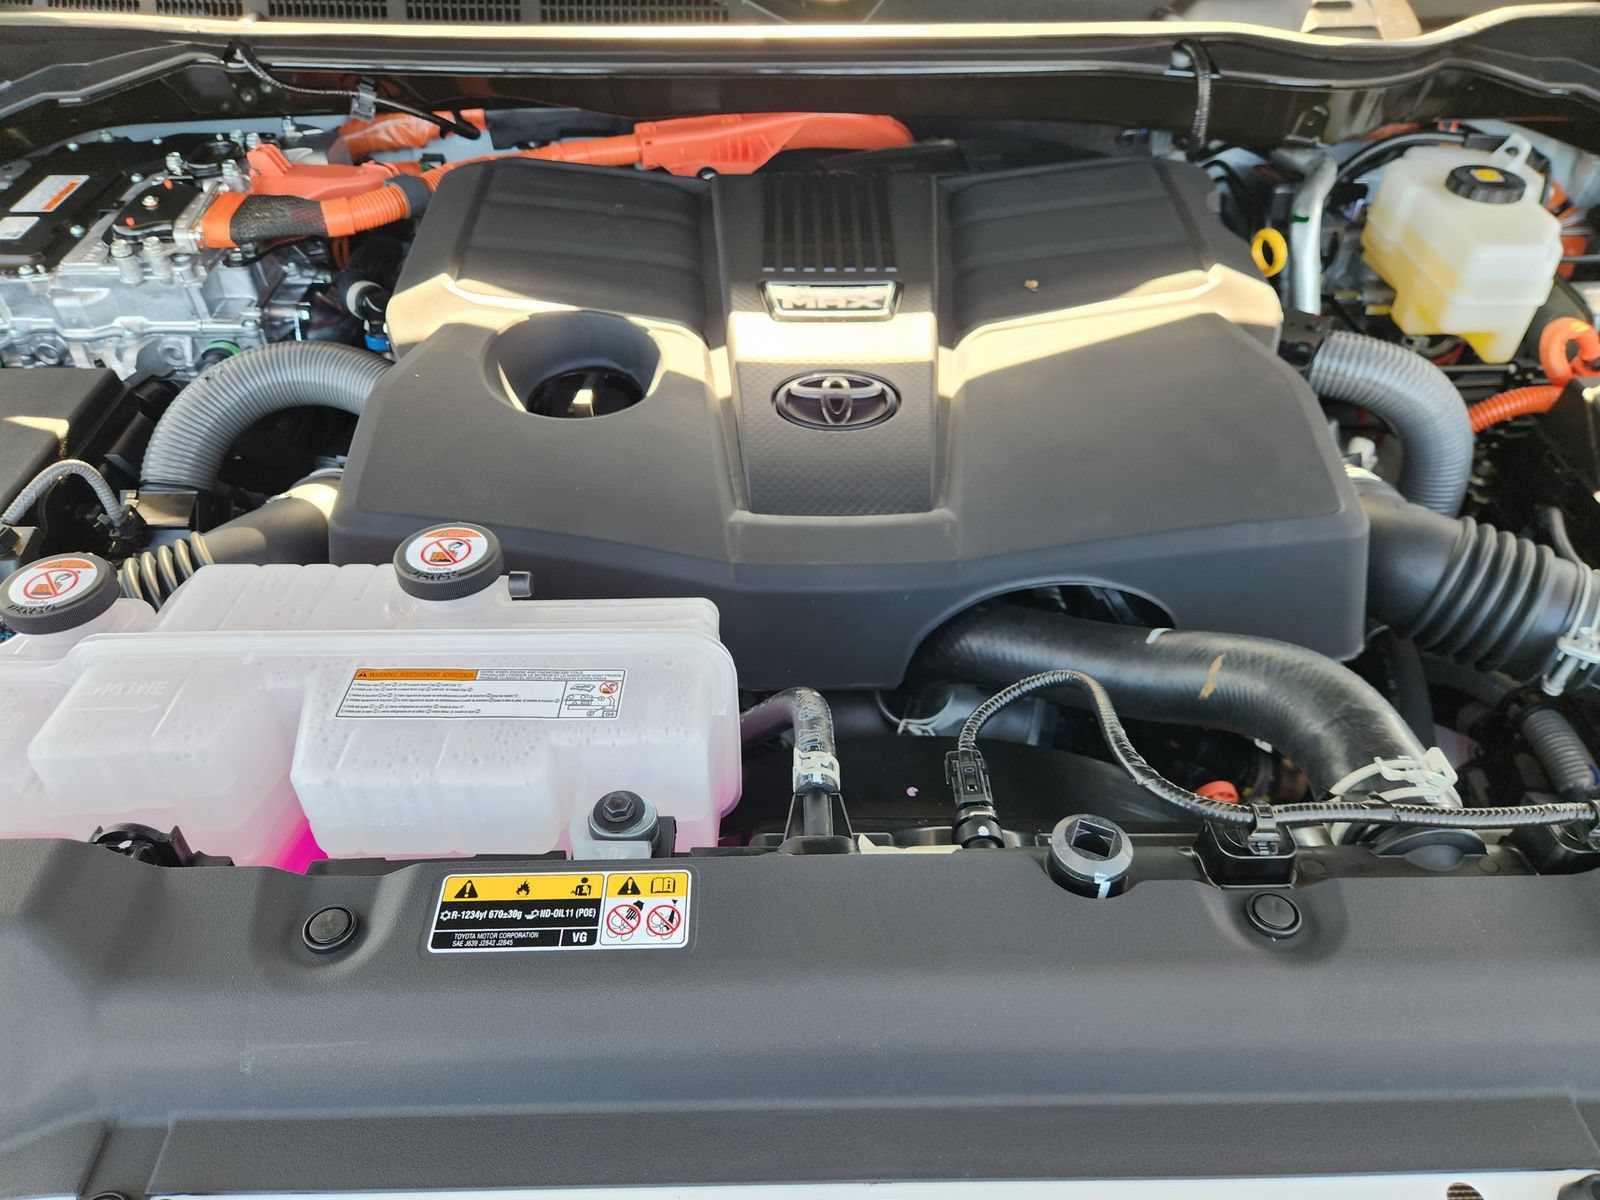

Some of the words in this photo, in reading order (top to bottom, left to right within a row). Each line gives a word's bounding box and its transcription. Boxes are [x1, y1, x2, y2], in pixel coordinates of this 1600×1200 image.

[451, 910, 487, 920] R-1234yf
[488, 910, 523, 920] 670±30g
[540, 909, 574, 918] ND-OIL11
[575, 908, 596, 919] (POE)
[572, 933, 588, 943] VG
